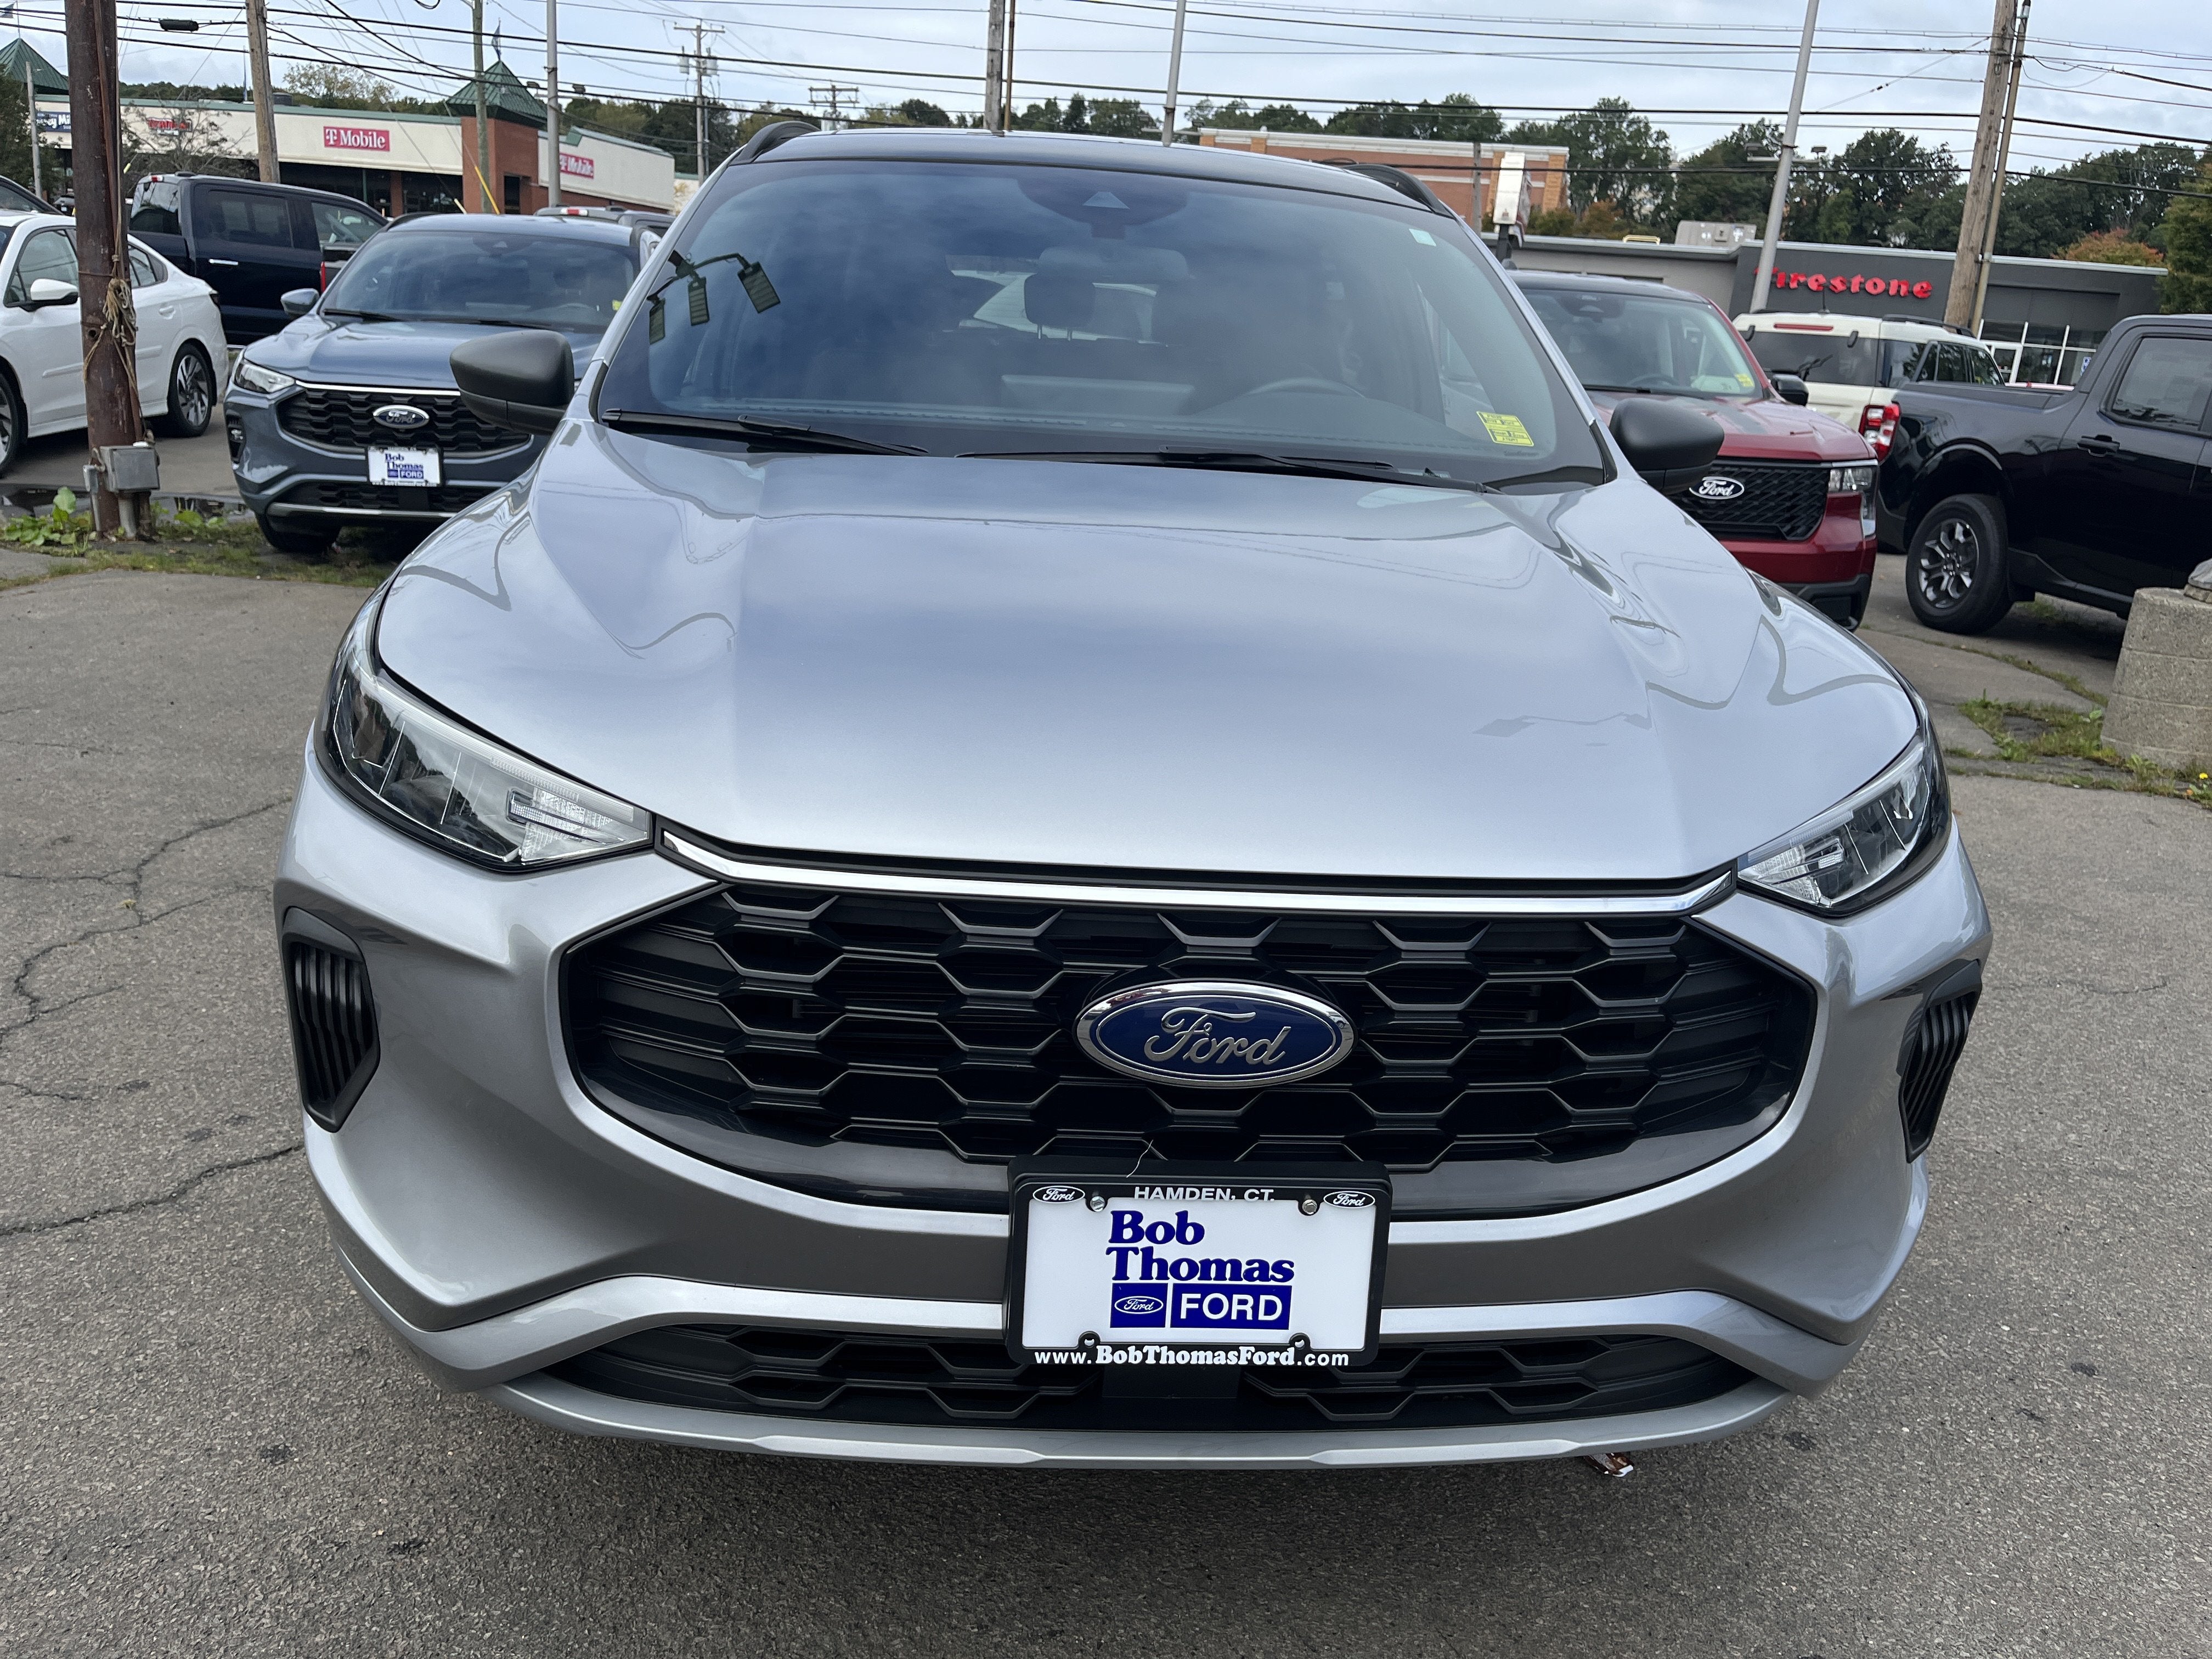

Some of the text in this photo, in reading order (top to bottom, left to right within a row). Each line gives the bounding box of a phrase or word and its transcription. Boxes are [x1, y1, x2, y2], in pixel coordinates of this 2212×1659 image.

[386, 410, 415, 424] Ford
[385, 453, 404, 461] Bob
[1699, 480, 1735, 496] Ford
[1144, 1007, 1291, 1065] Ford
[1042, 1188, 1075, 1201] Ford
[1134, 1187, 1274, 1201] HAMDEN, CT.
[1333, 1190, 1366, 1206] Ford
[1108, 1210, 1205, 1245] Bob
[1105, 1246, 1294, 1282] Thomas
[1124, 1299, 1154, 1311] Ford
[1180, 1293, 1282, 1321] FORD
[1035, 1346, 1348, 1366] www.BobThomasFord.com
